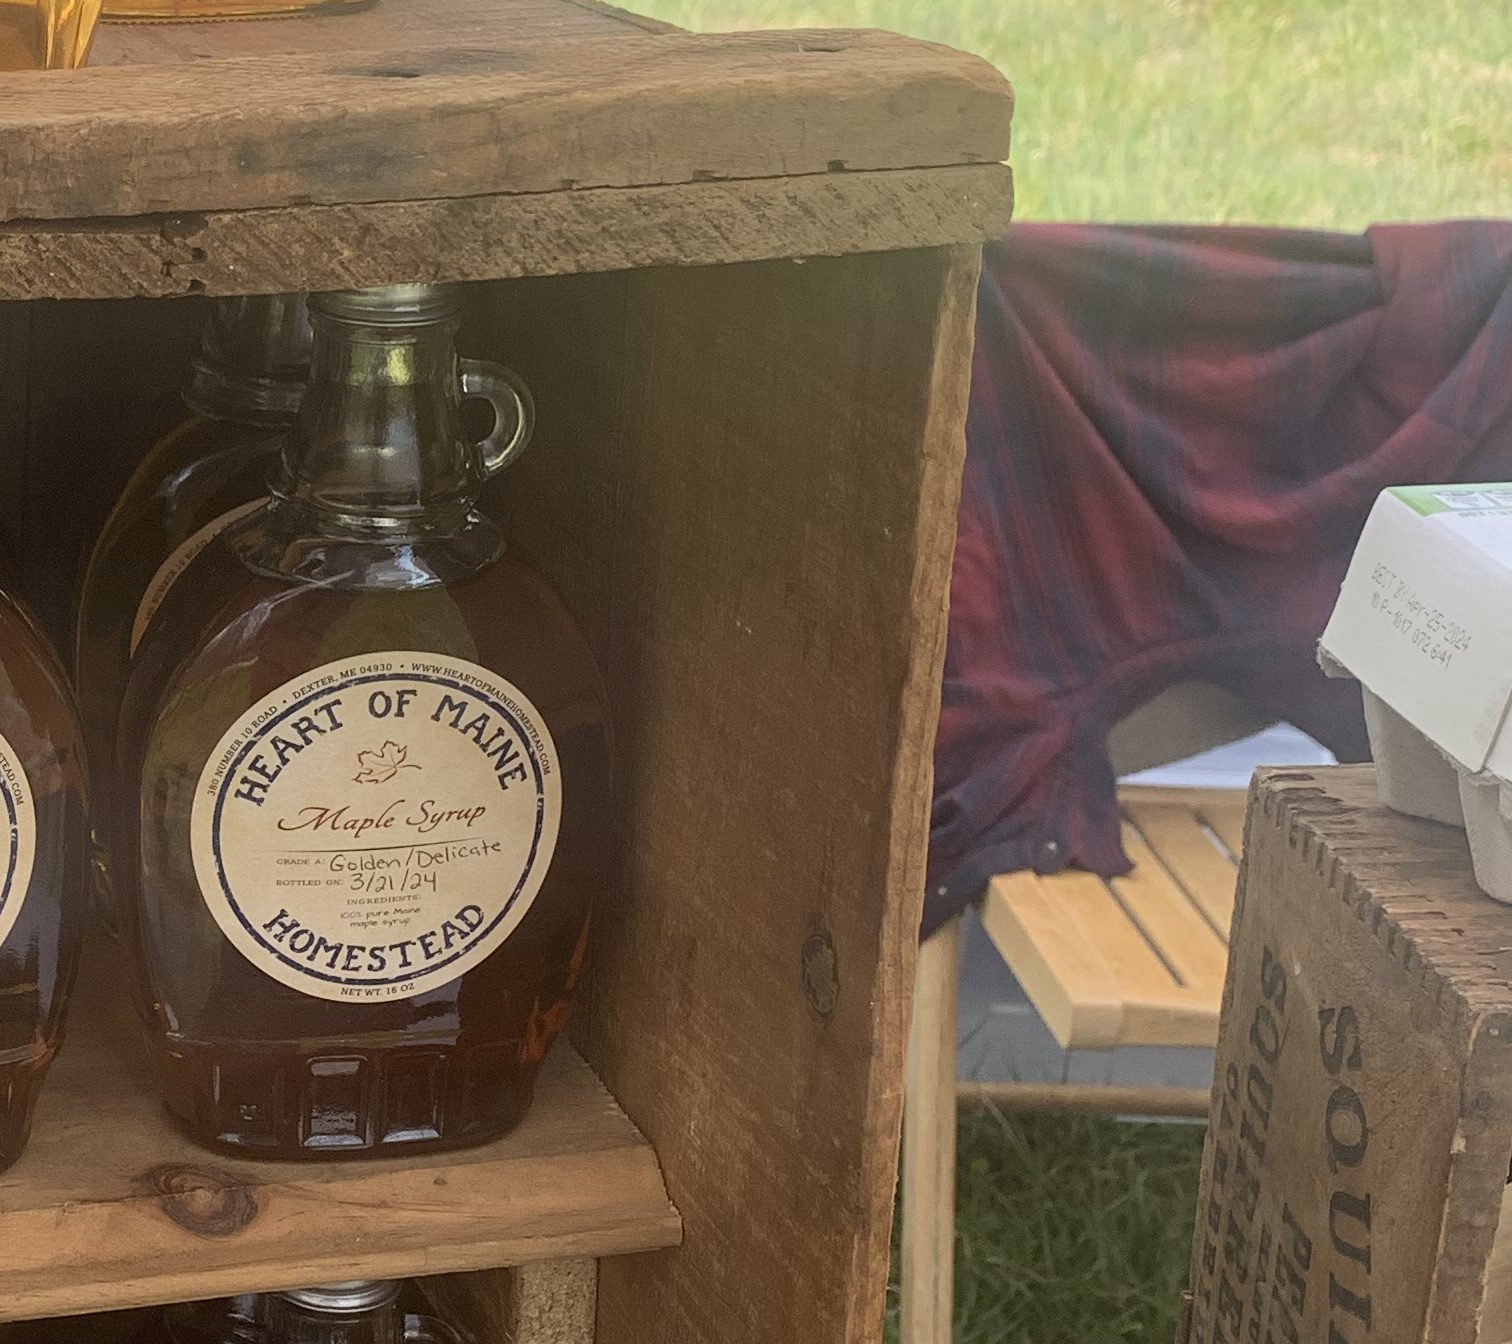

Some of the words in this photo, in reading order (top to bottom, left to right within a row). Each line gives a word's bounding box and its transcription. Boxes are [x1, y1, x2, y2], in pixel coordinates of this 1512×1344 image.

[339, 668, 357, 680] ME
[359, 663, 393, 675] 04930
[234, 699, 343, 807] HEART
[367, 689, 418, 719] OF
[430, 694, 527, 790] MAINE
[276, 798, 405, 838] Maple
[404, 799, 486, 833] Syrup
[262, 904, 483, 972] HOMESTEAD
